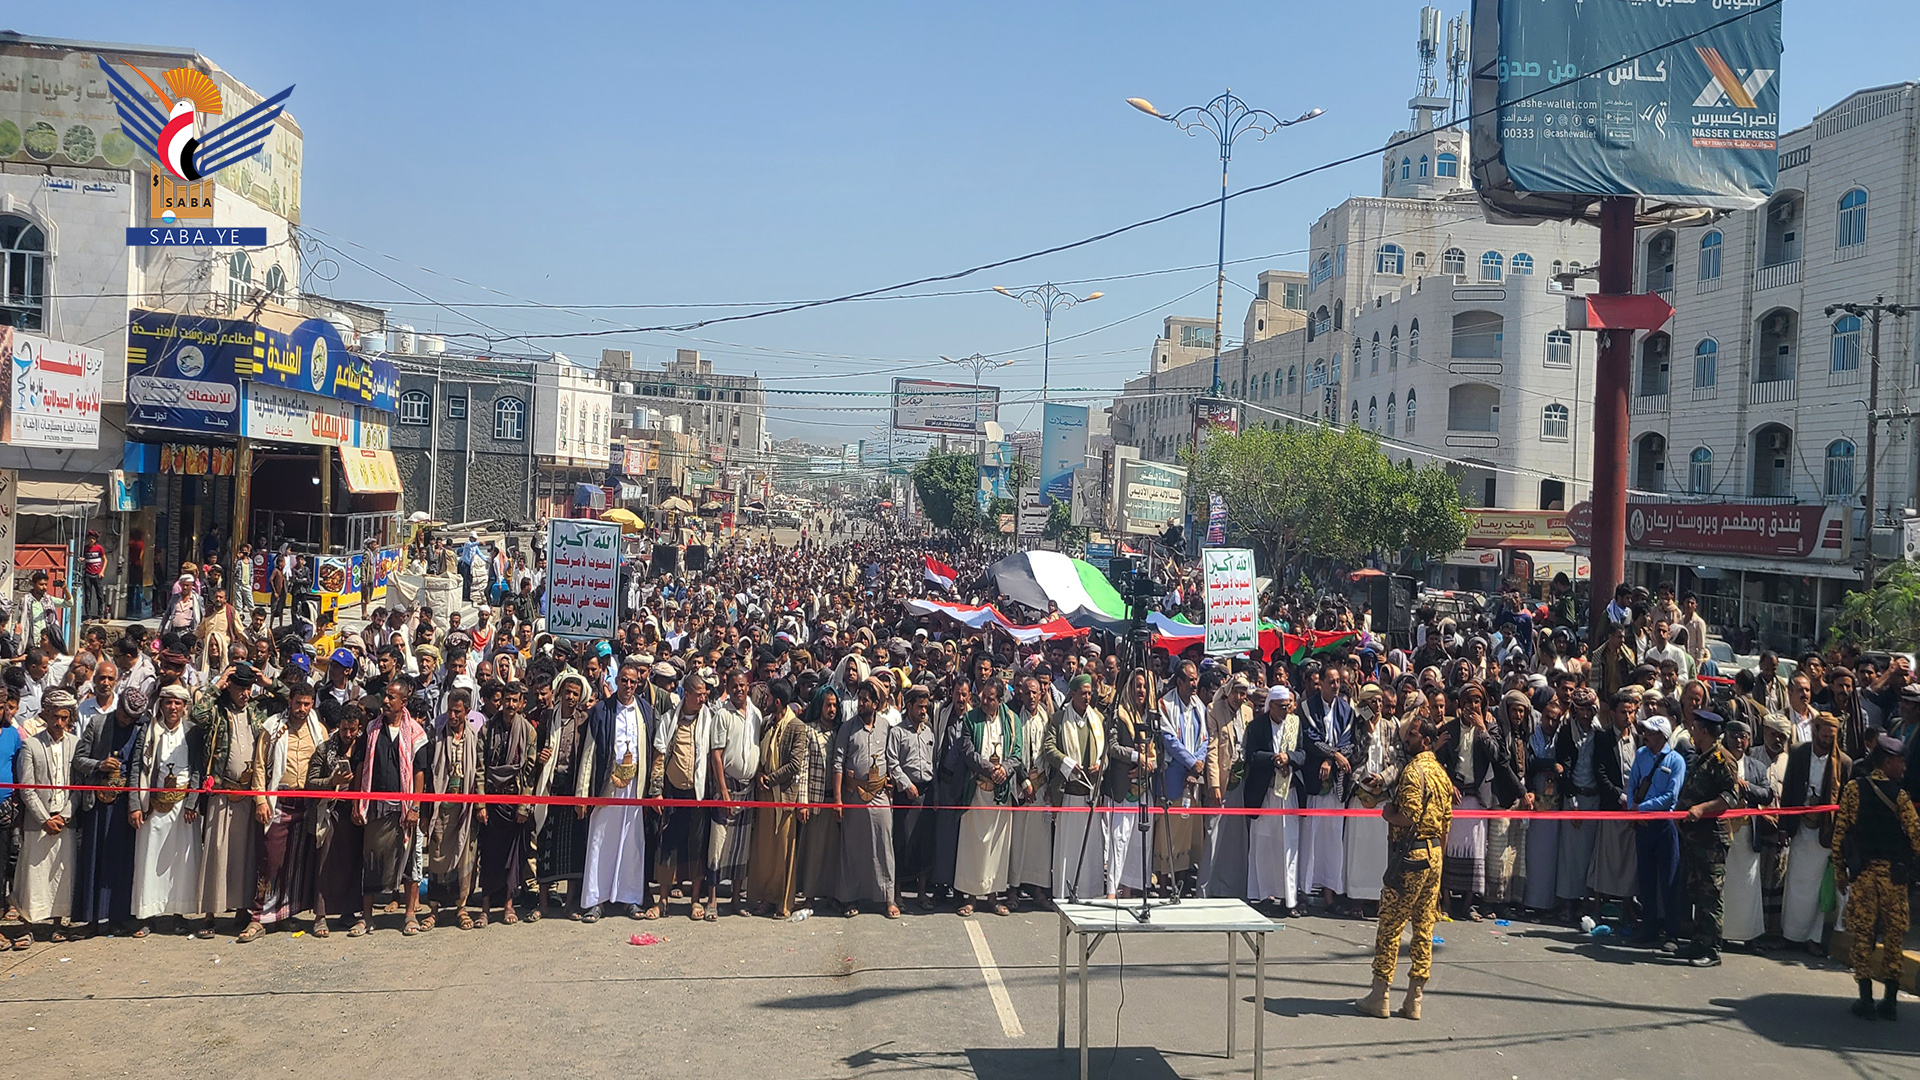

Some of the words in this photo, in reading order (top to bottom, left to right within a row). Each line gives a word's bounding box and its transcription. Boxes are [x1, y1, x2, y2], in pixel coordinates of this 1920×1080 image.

[1548, 59, 1577, 84] من
[1607, 55, 1667, 86] كاش
[29, 74, 82, 102] وحلويات
[1692, 111, 1747, 128] إكسبرس
[1748, 112, 1776, 128] ناصر
[1543, 128, 1597, 139] @cashewallet
[1692, 128, 1730, 138] NASSER
[1733, 129, 1777, 139] EXPRESS
[83, 182, 116, 195] مطعم
[132, 323, 178, 339] العنيدة
[180, 327, 217, 345] وبروست
[220, 331, 253, 346] مطاعم
[34, 344, 86, 377] الشفاء
[267, 337, 302, 382] العنيدة
[43, 388, 74, 414] الصيدلانية
[76, 386, 100, 416] للأدوية
[186, 389, 231, 404] للأسماك
[254, 391, 277, 419] البحرية
[278, 394, 309, 425] والمأكولات
[204, 416, 229, 428] جملة
[311, 402, 350, 444] للأسماك
[1048, 416, 1083, 427] شملان
[1473, 519, 1502, 529] ريمان
[1504, 520, 1535, 529] ماركت
[1646, 509, 1673, 533] ريمان
[1675, 510, 1718, 535] وبروست
[1721, 511, 1765, 537] ومطعم
[1768, 510, 1801, 537] فندق
[555, 526, 593, 551] أكبر
[593, 530, 616, 549] الله
[554, 552, 586, 568] لأمريكا
[588, 557, 614, 571] الموت
[1209, 552, 1234, 576] أكبر
[1236, 555, 1250, 571] الله
[553, 572, 585, 590] لإسرائيل
[588, 577, 613, 591] الموت
[1210, 576, 1233, 591] لأمريكا
[1235, 577, 1251, 590] الموت
[552, 593, 575, 608] اليهود
[577, 594, 590, 609] على
[593, 594, 612, 609] اللعنة
[1210, 594, 1233, 609] لإسرائيل
[1235, 595, 1252, 608] الموت
[551, 609, 583, 632] للإسلام
[584, 612, 612, 632] النصر
[1210, 612, 1227, 626] اليهود
[1229, 613, 1237, 625] على
[1239, 611, 1253, 623] اللعنة
[1210, 628, 1233, 647] للإسلام
[1234, 626, 1252, 645] النصر
